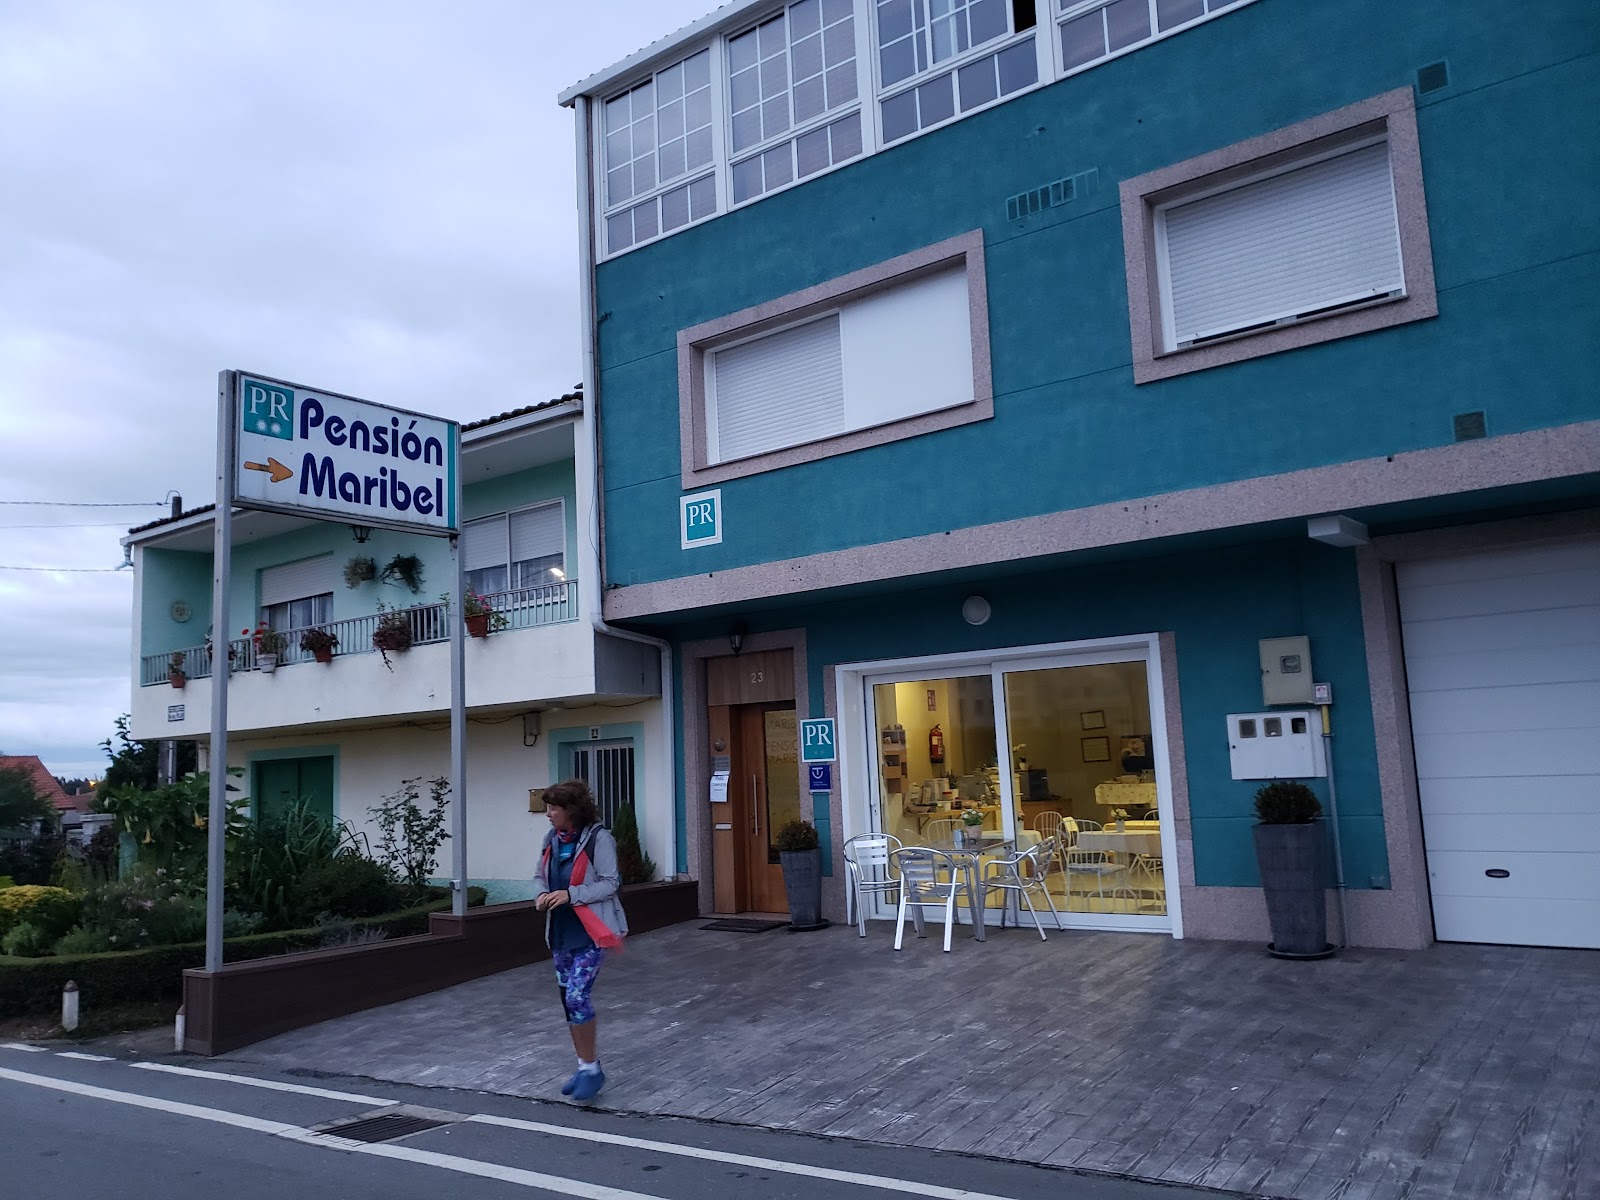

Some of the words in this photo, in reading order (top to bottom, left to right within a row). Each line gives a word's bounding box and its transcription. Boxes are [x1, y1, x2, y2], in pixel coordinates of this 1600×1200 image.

[248, 386, 290, 422] PR
[299, 397, 443, 467] Pensión
[299, 452, 443, 517] Maribel
[688, 503, 714, 527] PR
[750, 671, 764, 684] 23
[805, 724, 832, 746] PR
